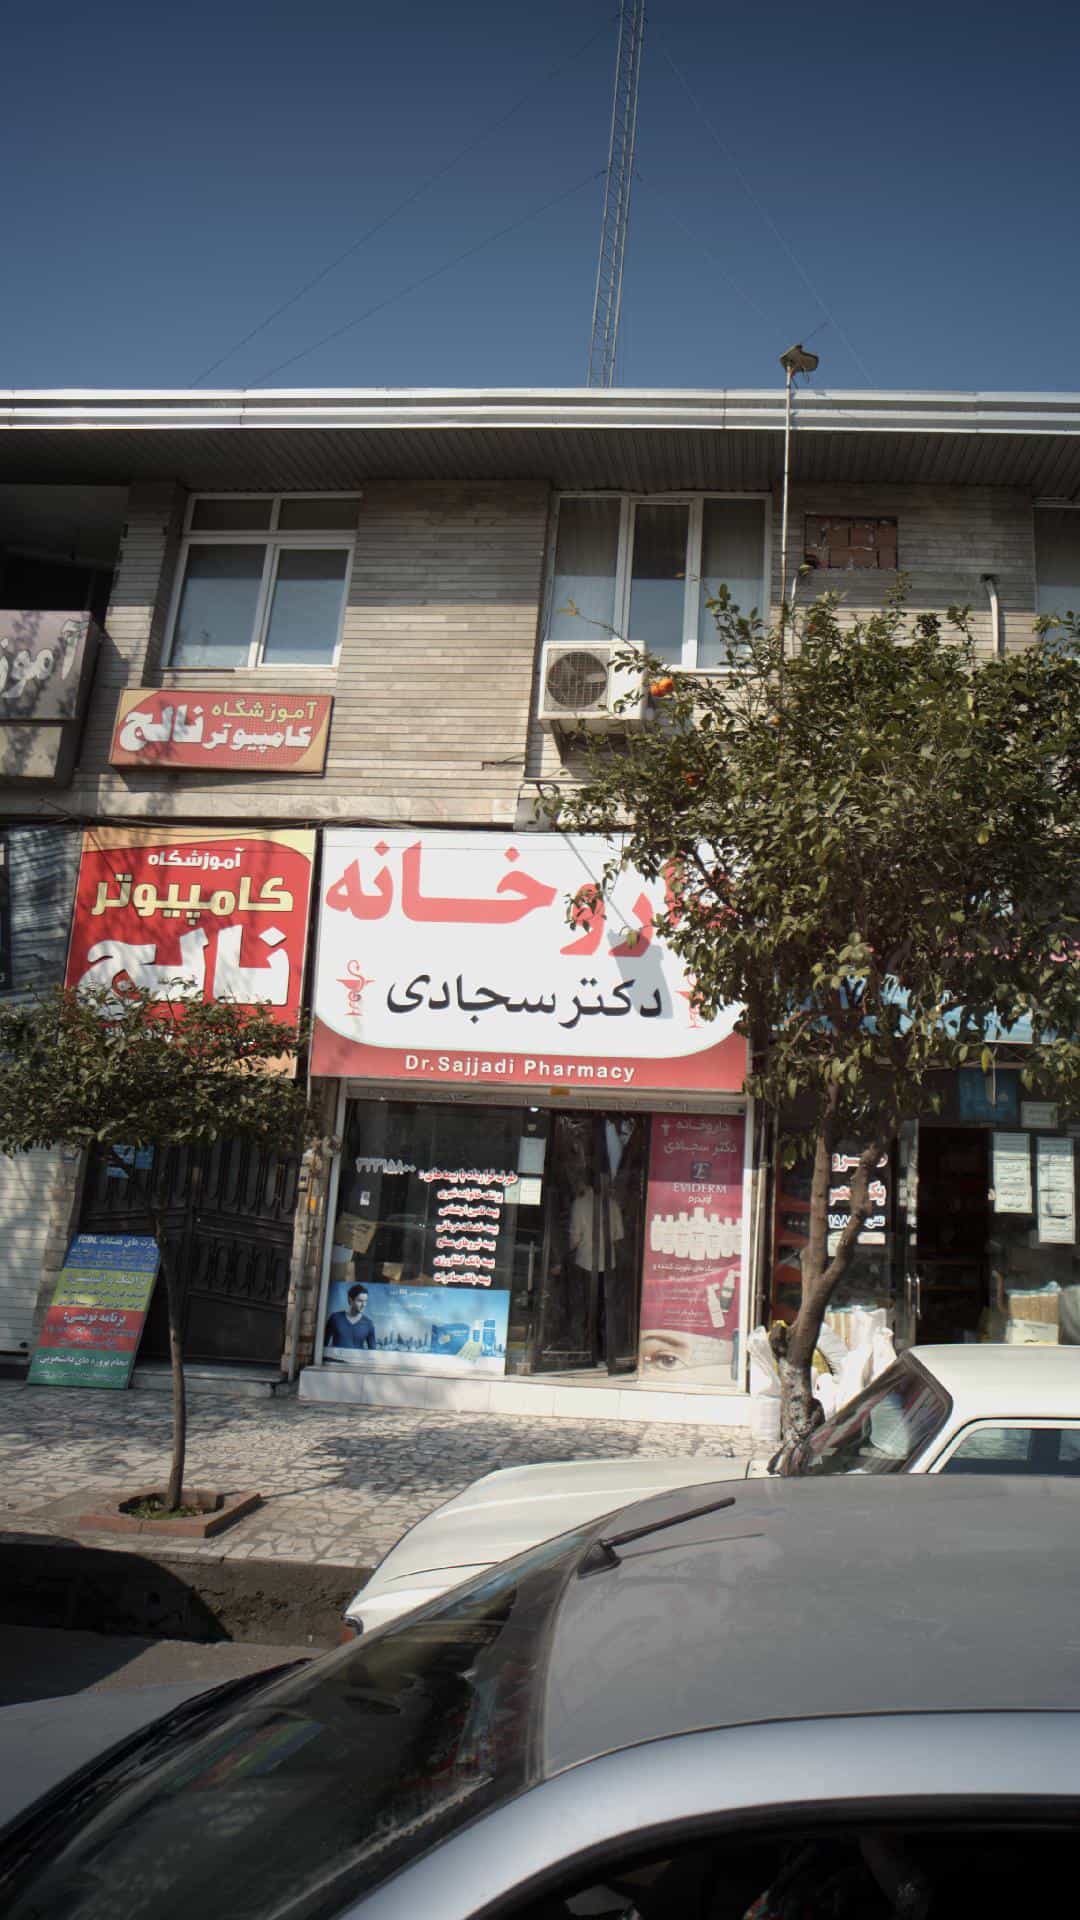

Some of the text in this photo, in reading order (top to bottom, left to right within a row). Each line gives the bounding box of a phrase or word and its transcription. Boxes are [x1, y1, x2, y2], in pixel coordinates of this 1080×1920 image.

[119, 704, 312, 753] کامپیوتر نالج
[211, 700, 317, 721] آموزشگاه
[147, 847, 245, 870] آموزشگاه
[91, 872, 294, 925] کامپیوتر
[75, 924, 290, 1021] نالج
[386, 973, 663, 1029] دکتر سجادی
[523, 1060, 636, 1083] Pharmacy
[672, 1182, 727, 1195] EVIDERM
